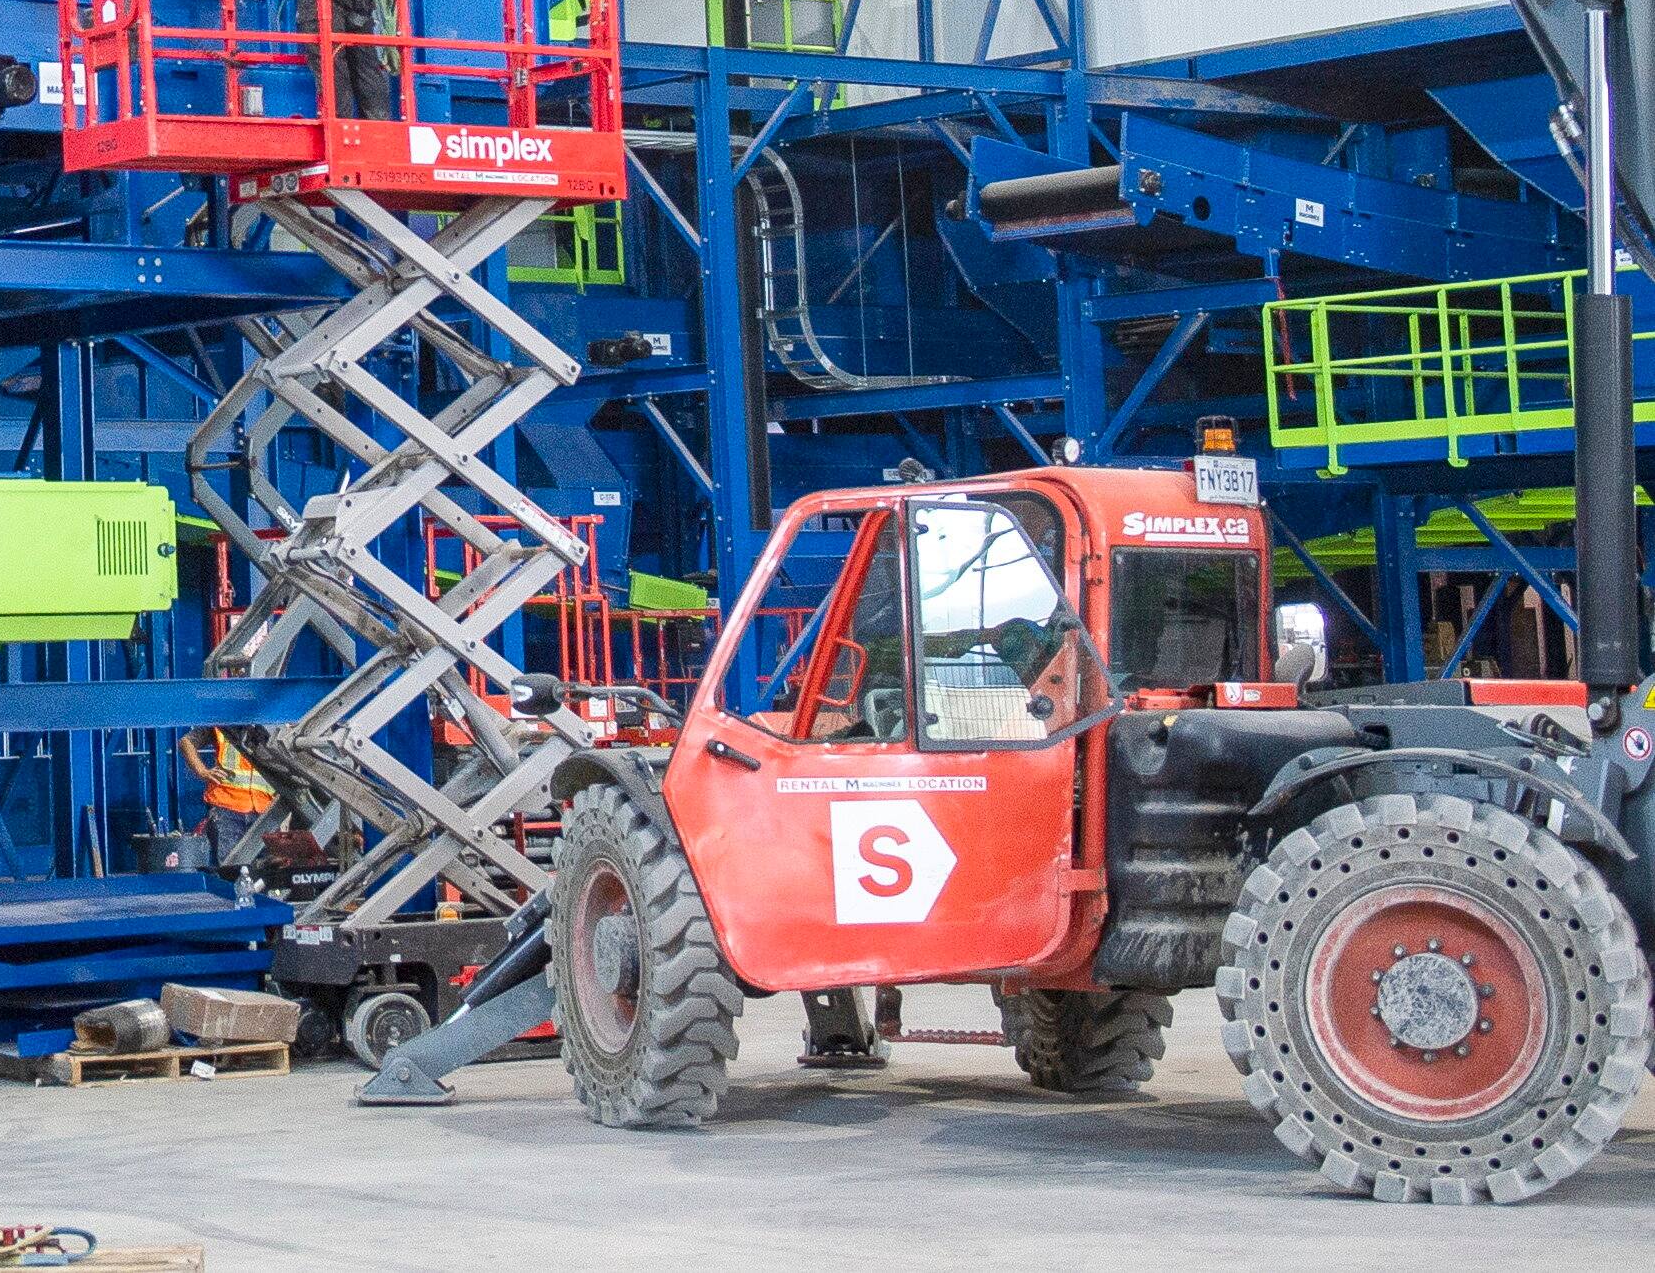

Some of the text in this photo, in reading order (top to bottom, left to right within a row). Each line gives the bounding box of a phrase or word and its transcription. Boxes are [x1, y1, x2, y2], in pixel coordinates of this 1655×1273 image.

[446, 128, 553, 167] simplex
[1198, 468, 1254, 493] FNY3817
[1122, 512, 1249, 538] SIMPLEX.ca
[780, 779, 838, 791] RENTAL
[846, 779, 860, 791] M
[908, 777, 984, 789] LOCATION
[858, 824, 913, 898] S
